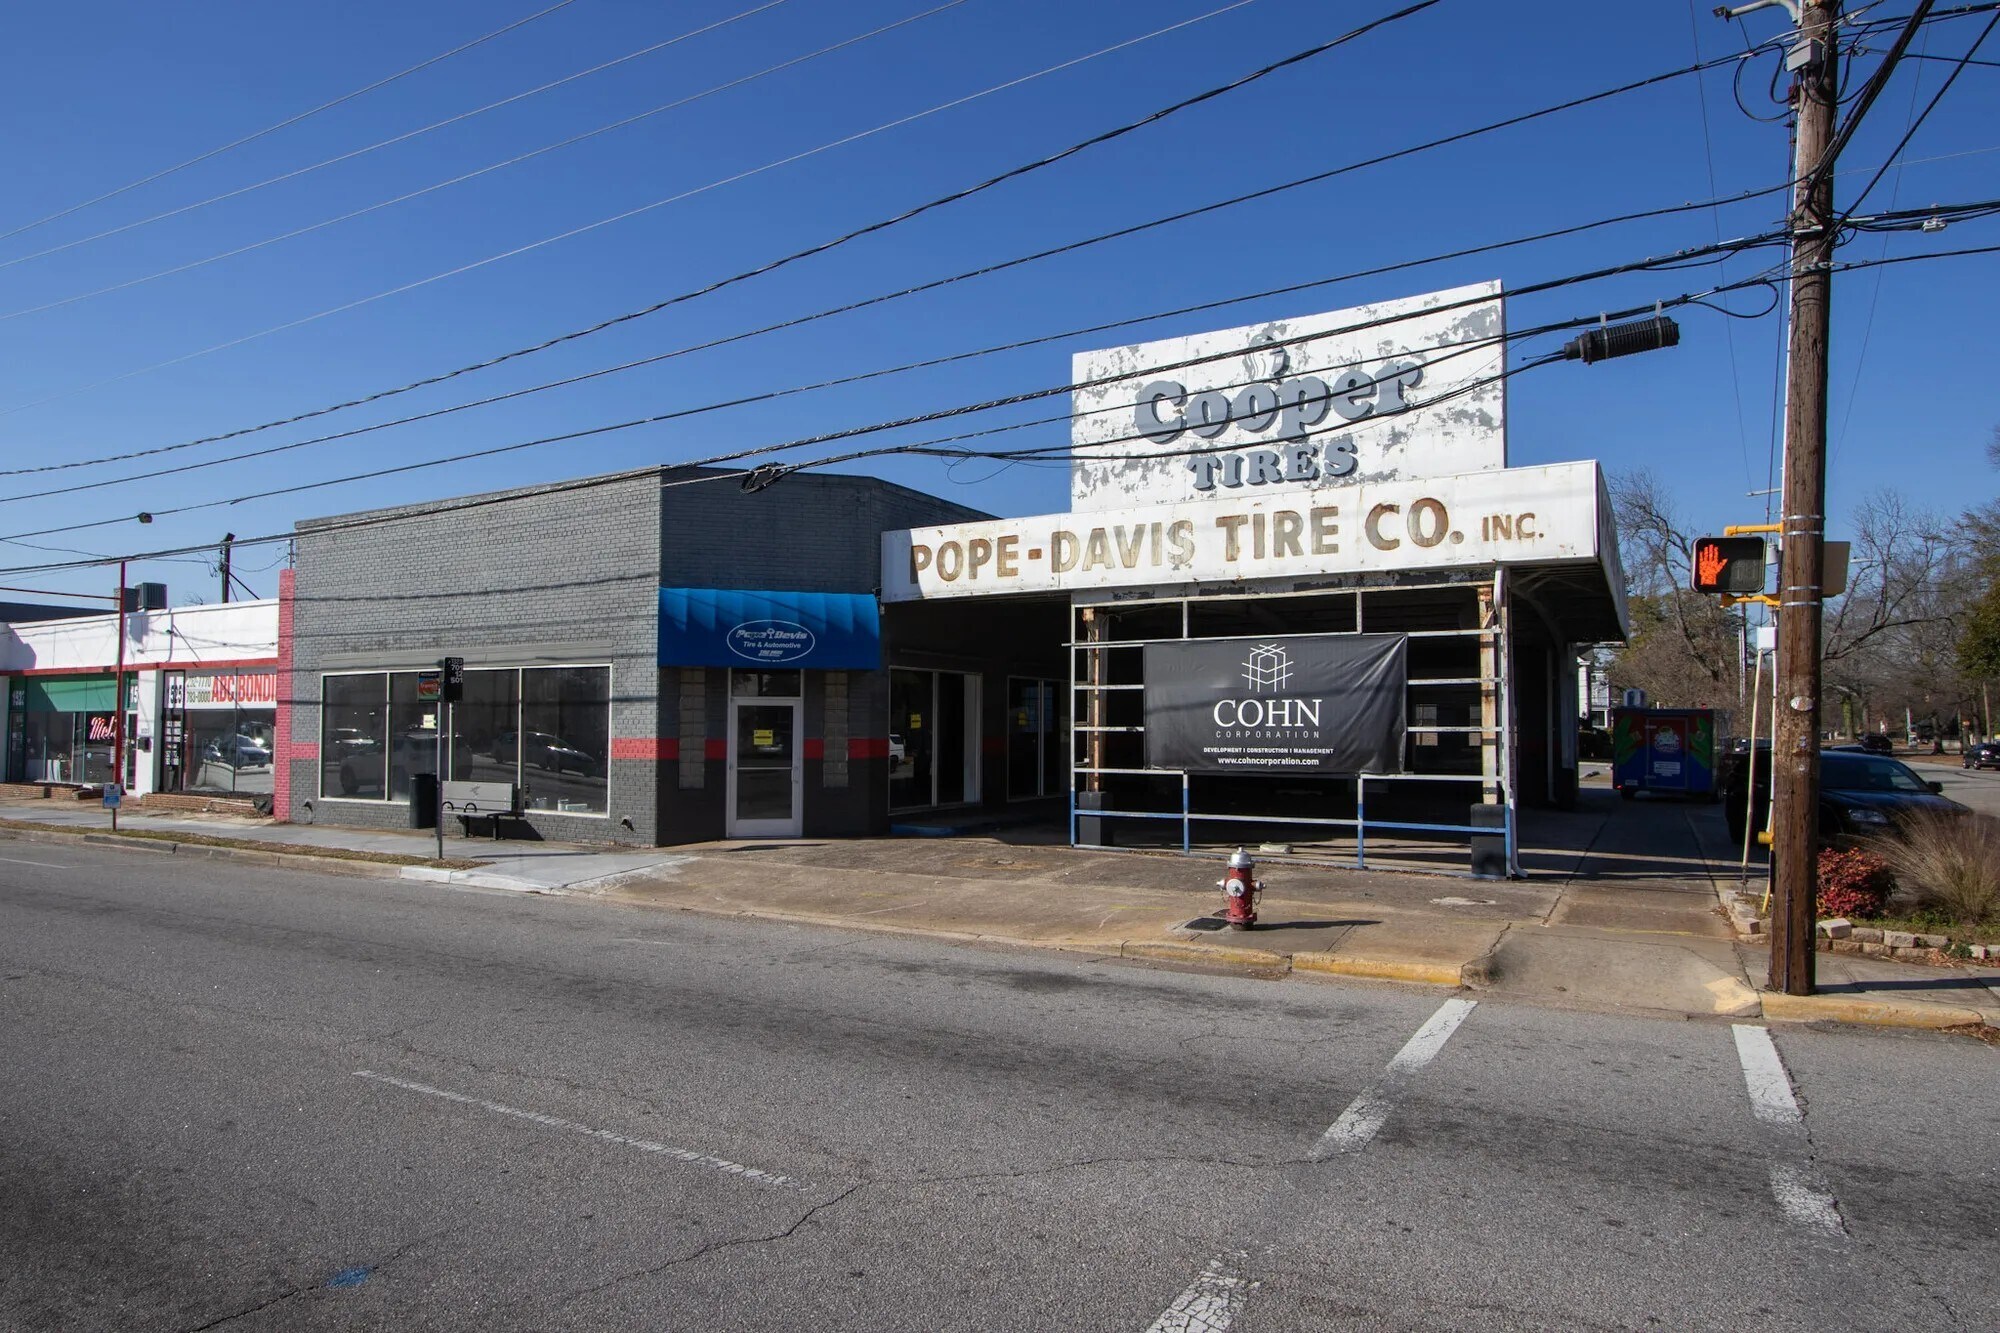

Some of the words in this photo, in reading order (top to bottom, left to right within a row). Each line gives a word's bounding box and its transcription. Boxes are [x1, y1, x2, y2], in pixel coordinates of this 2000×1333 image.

[1134, 360, 1424, 444] Cooper
[1187, 439, 1359, 490] TIRES
[1215, 506, 1340, 562] TIRE
[1365, 497, 1464, 551] CO.
[1482, 512, 1545, 542] INC.
[763, 641, 802, 649] Automotive
[211, 675, 236, 703] ABC
[1213, 699, 1323, 728] COHN
[1215, 730, 1320, 739] CORPORATION
[1217, 757, 1320, 766] www.cohncorporation.com
